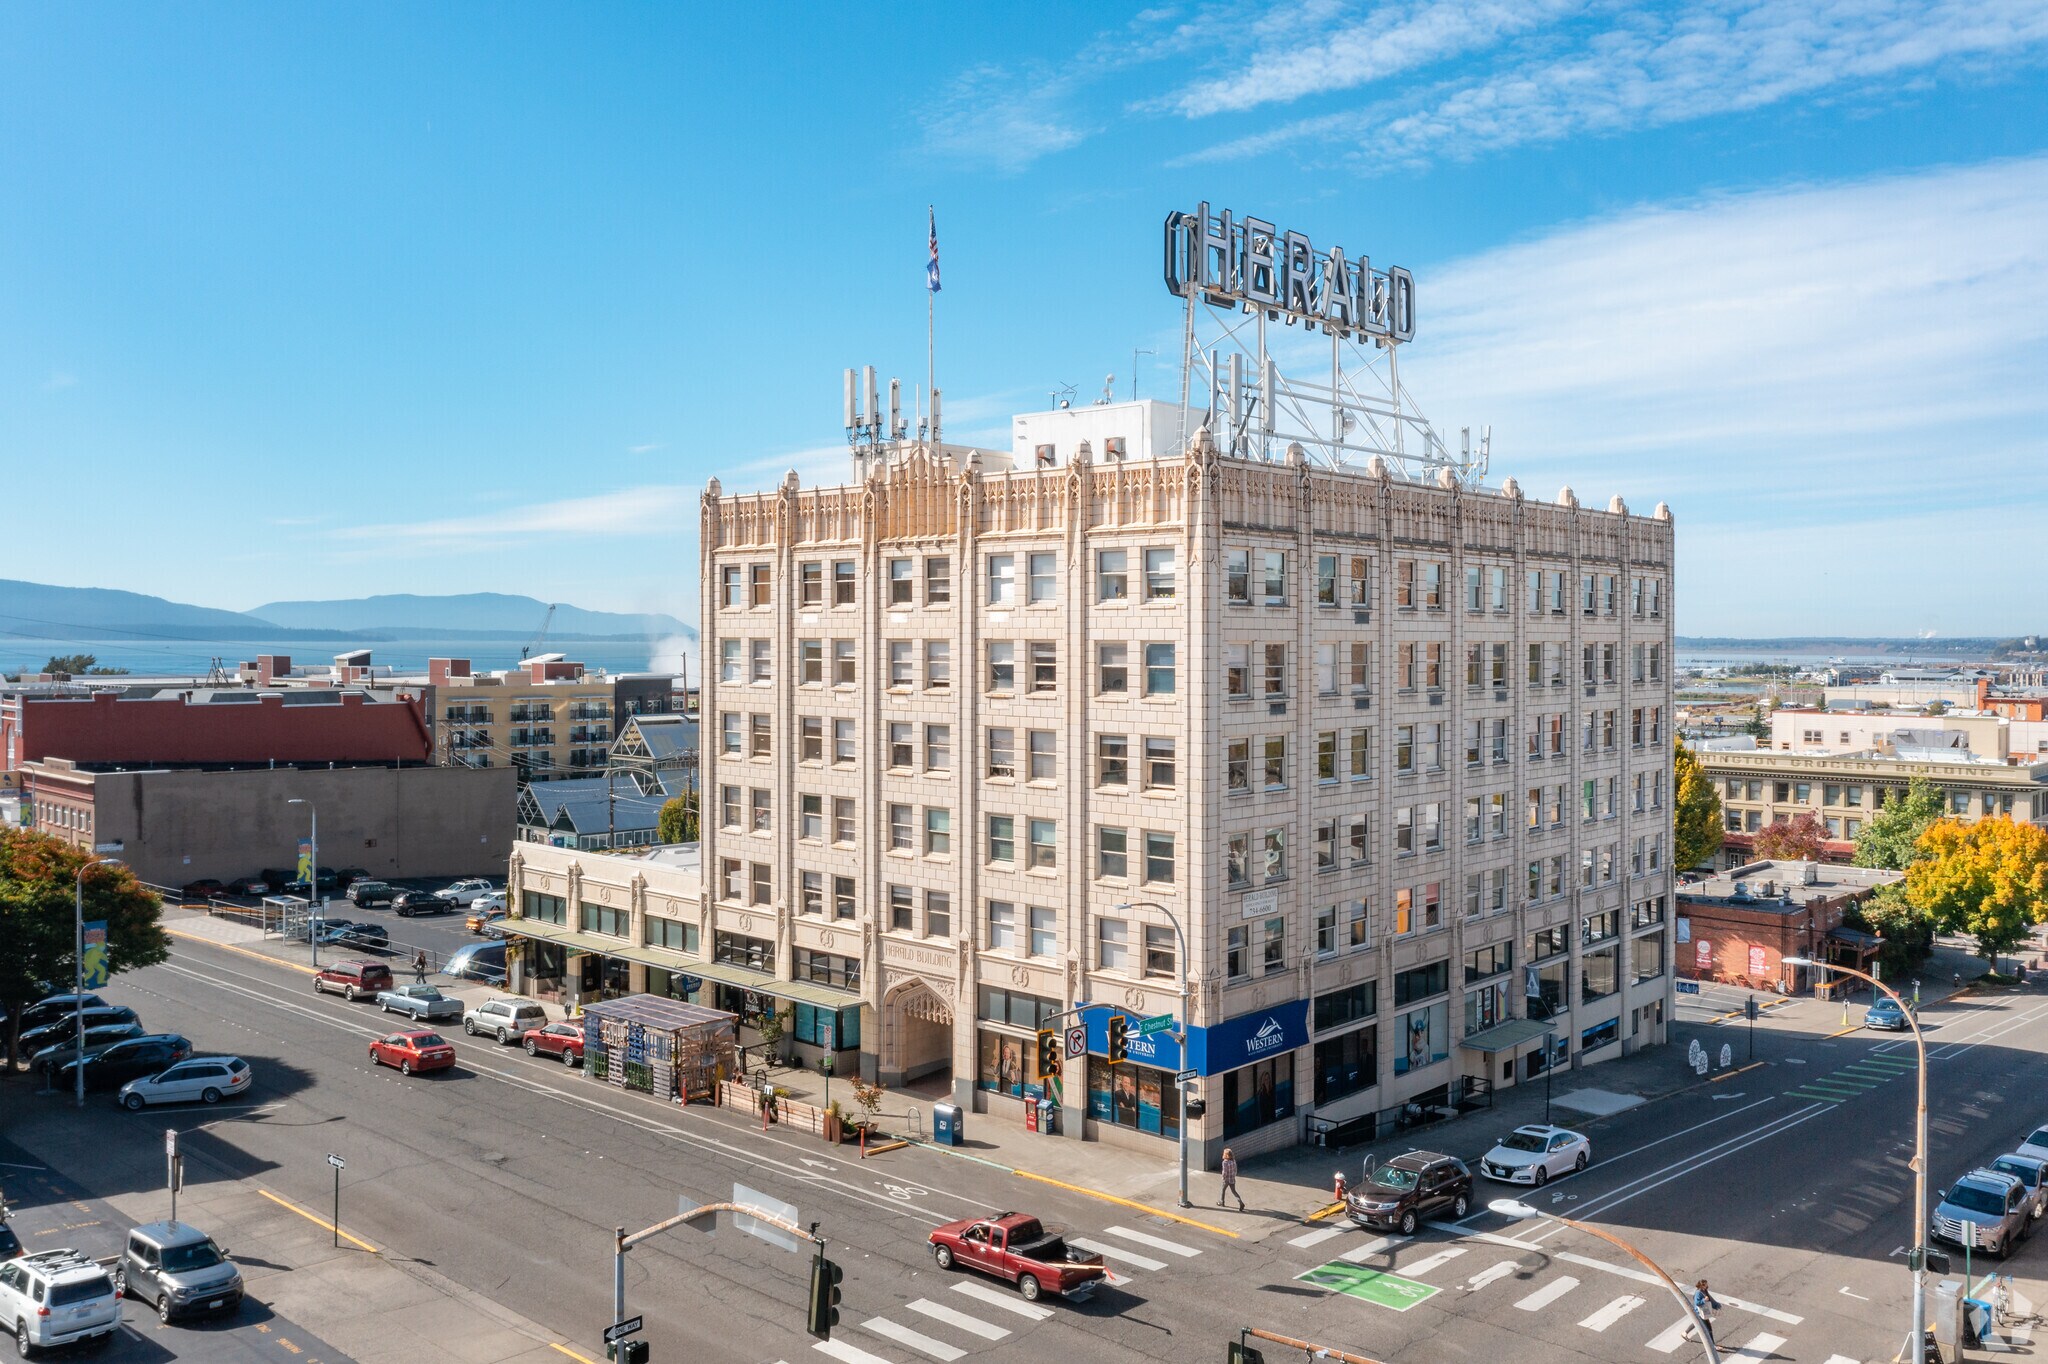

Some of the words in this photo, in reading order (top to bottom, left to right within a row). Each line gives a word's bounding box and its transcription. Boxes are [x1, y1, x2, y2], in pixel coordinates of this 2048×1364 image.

[1197, 200, 1416, 342] HERALD
[1697, 754, 1777, 766] HINGTON
[1790, 758, 1880, 770] GROCERY
[1895, 764, 1994, 777] BUILDING
[885, 944, 914, 960] HERALD
[916, 950, 952, 968] BUILDING
[1145, 1019, 1166, 1032] Chestnut
[1246, 1032, 1284, 1052] WESTERN
[615, 1325, 627, 1335] ONE
[627, 1321, 640, 1331] WAY
